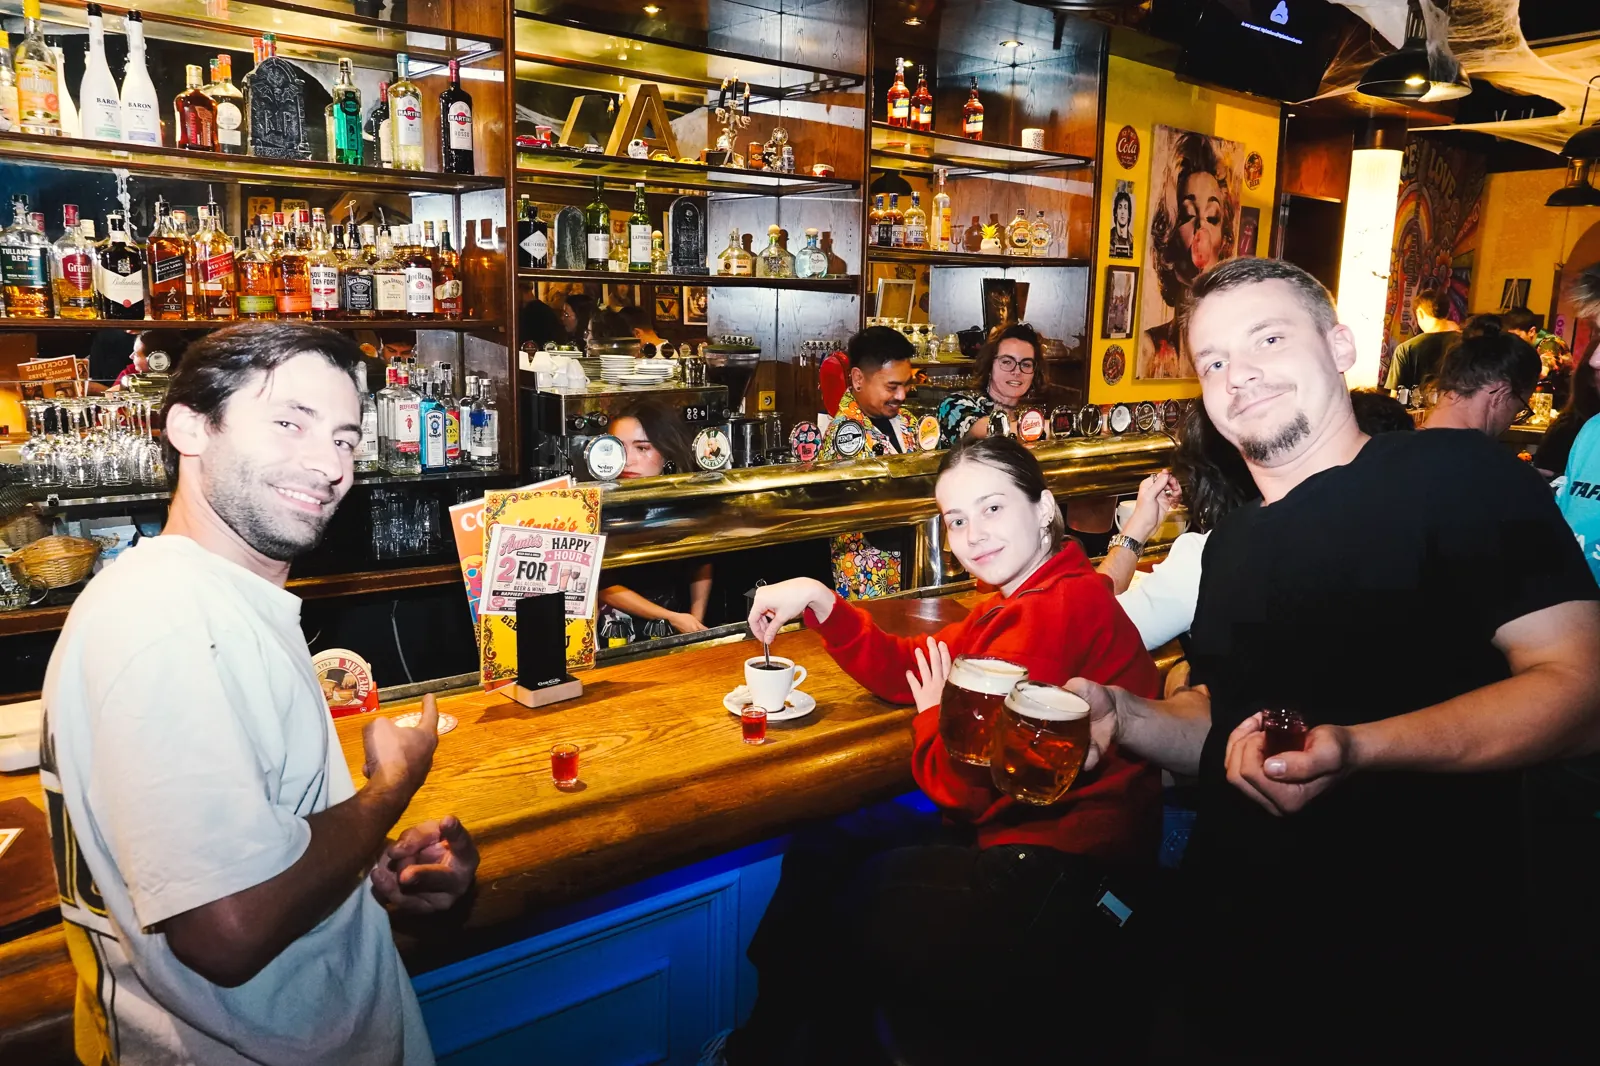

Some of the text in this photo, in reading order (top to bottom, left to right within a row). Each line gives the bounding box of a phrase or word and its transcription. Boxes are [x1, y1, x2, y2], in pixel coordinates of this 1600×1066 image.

[1118, 137, 1137, 154] Cola
[1428, 147, 1456, 197] LOVE
[1250, 179, 1260, 188] BEER
[499, 534, 543, 556] Annie's
[552, 537, 591, 552] HAPPY
[554, 551, 582, 562] HOUR
[497, 557, 560, 586] 2 FOR 1
